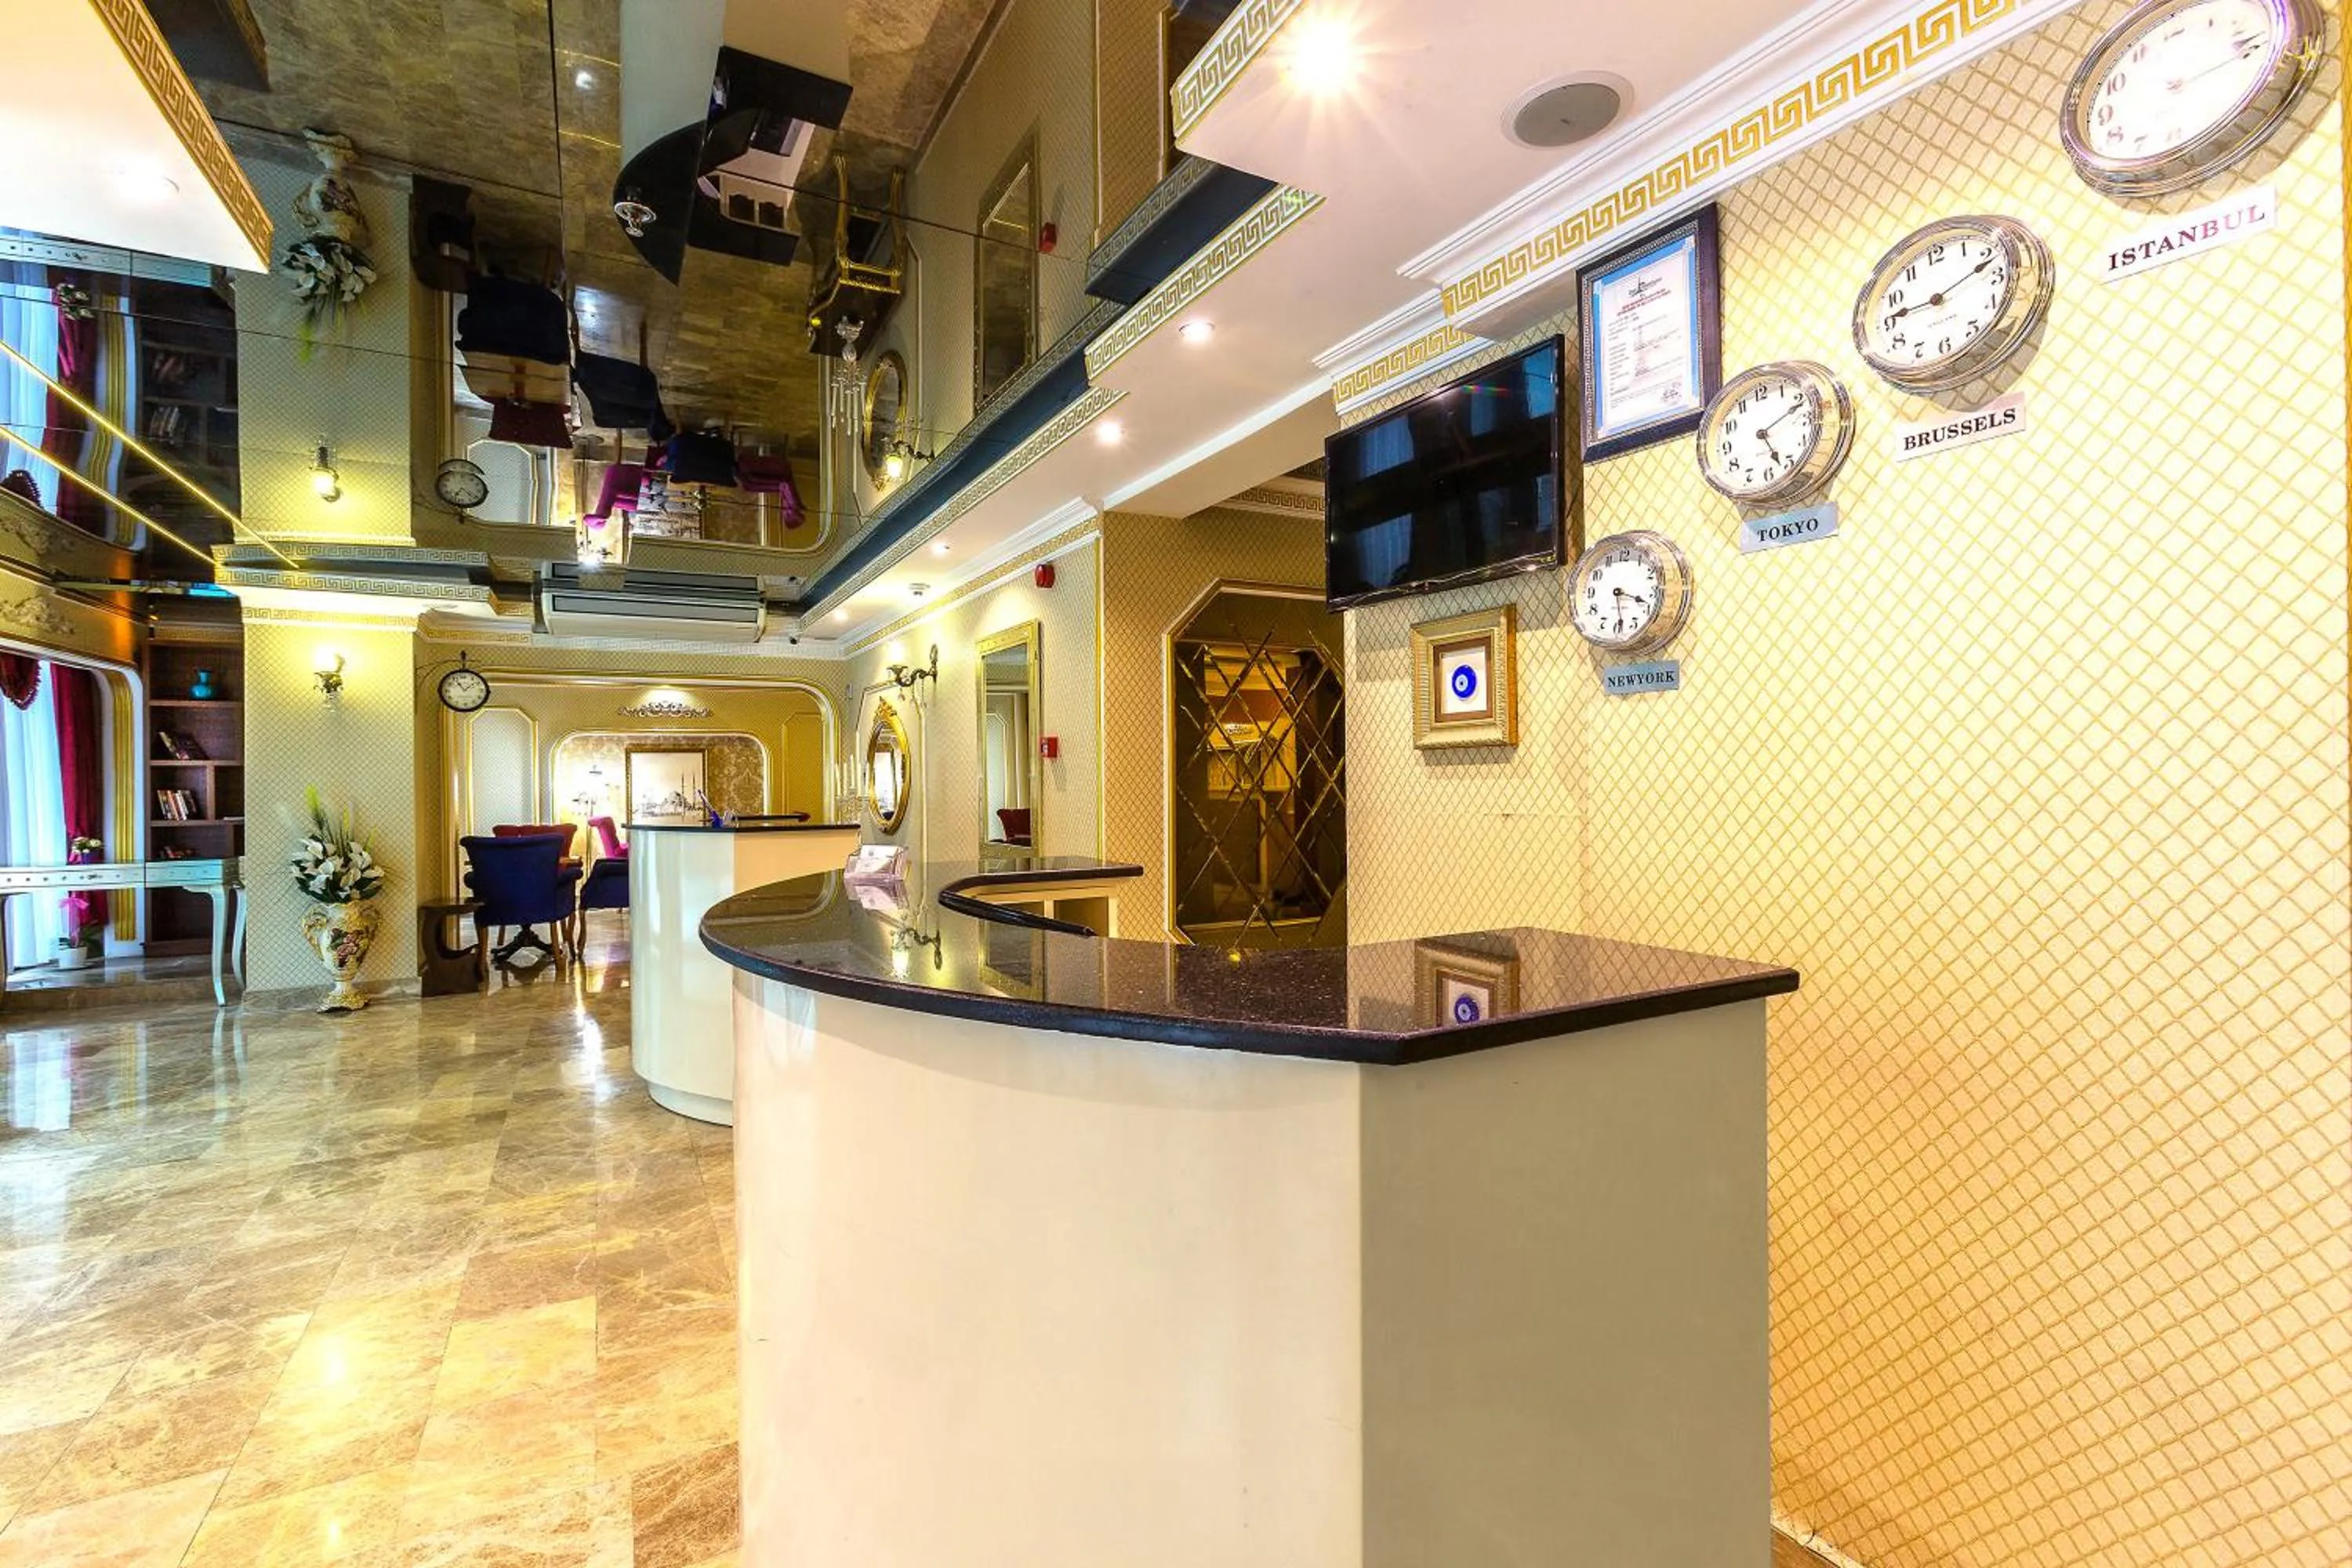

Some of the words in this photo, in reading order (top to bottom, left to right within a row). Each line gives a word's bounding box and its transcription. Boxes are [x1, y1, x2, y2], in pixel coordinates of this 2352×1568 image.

[2107, 72, 2126, 96] 10
[2097, 103, 2114, 126] 9
[2107, 205, 2266, 272] ISTANBUL
[1928, 244, 1945, 266] 12
[1961, 241, 1966, 257] 1
[1980, 247, 1992, 262] 2
[1906, 264, 1917, 282] 11
[1991, 266, 2004, 285] 3
[1888, 289, 1904, 308] 10
[1984, 292, 1996, 310] 4
[1884, 316, 1896, 332] 9
[1965, 319, 1980, 338] 5
[1891, 332, 1906, 350] 8
[1938, 336, 1951, 354] 6
[1914, 341, 1925, 358] 7
[1755, 385, 1768, 402] 12
[1780, 385, 1784, 398] 1
[1793, 393, 1804, 406] 2
[1738, 398, 1747, 415] 11
[1726, 418, 1737, 435] 10
[1903, 407, 2016, 452] BRUSSELS
[1722, 441, 1732, 456] 9
[1729, 457, 1740, 472] 8
[1784, 454, 1795, 470] 5
[1745, 468, 1754, 483] 7
[1763, 466, 1774, 482] 6
[1757, 517, 1819, 543] TOKYO
[1605, 554, 1613, 568] 11
[1619, 550, 1631, 562] 12
[1638, 554, 1642, 567] 1
[1592, 568, 1603, 582] 10
[1588, 586, 1595, 600] 9
[1589, 603, 1599, 615] 8
[1600, 617, 1608, 630] 7
[1629, 617, 1639, 630] 5
[1607, 670, 1675, 688] NEWYORK
